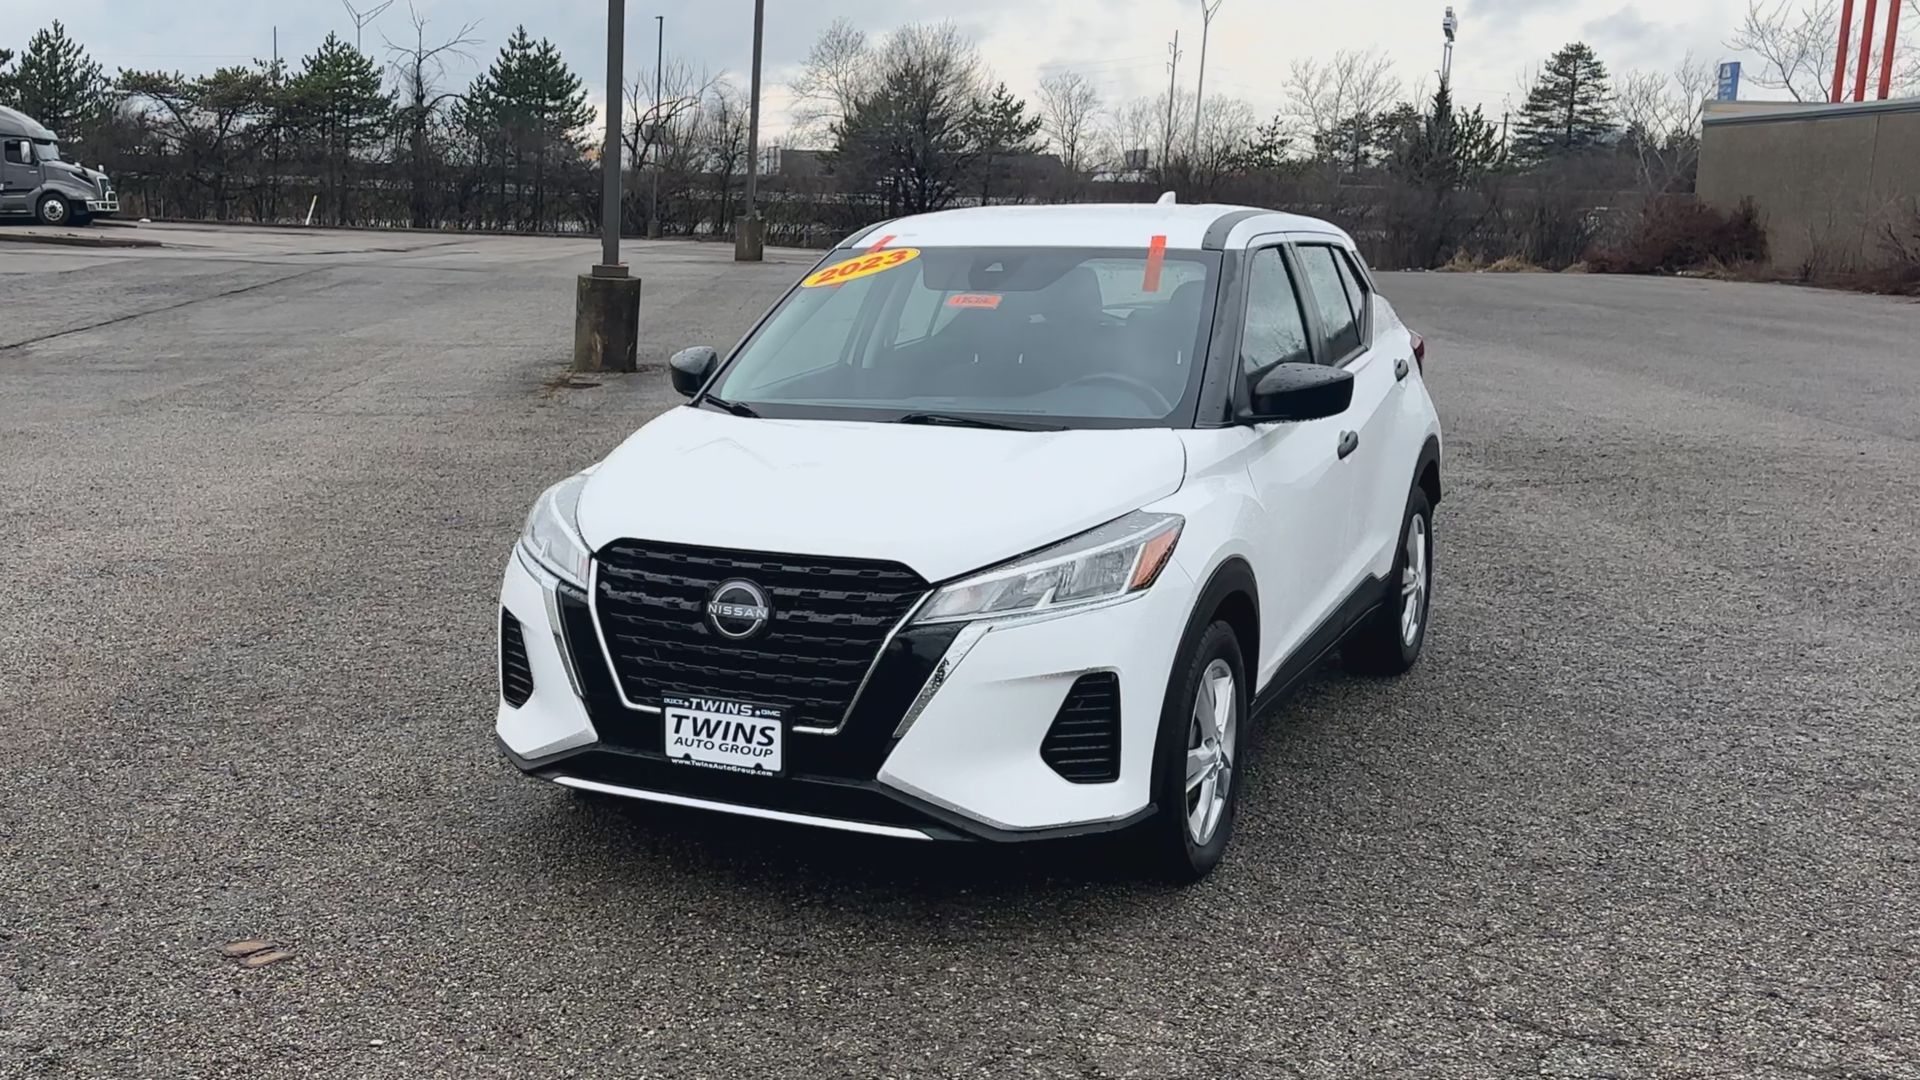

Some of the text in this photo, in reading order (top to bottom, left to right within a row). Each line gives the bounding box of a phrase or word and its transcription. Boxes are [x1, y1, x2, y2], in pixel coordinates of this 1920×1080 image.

[814, 249, 907, 284] 2023
[708, 603, 767, 618] NISSAN
[690, 698, 752, 716] TWINS
[760, 709, 781, 717] GMC
[671, 714, 776, 747] TWINS
[674, 736, 773, 758] AUTO GROUP
[671, 758, 773, 776] www.TwinsAutoGroup.com
